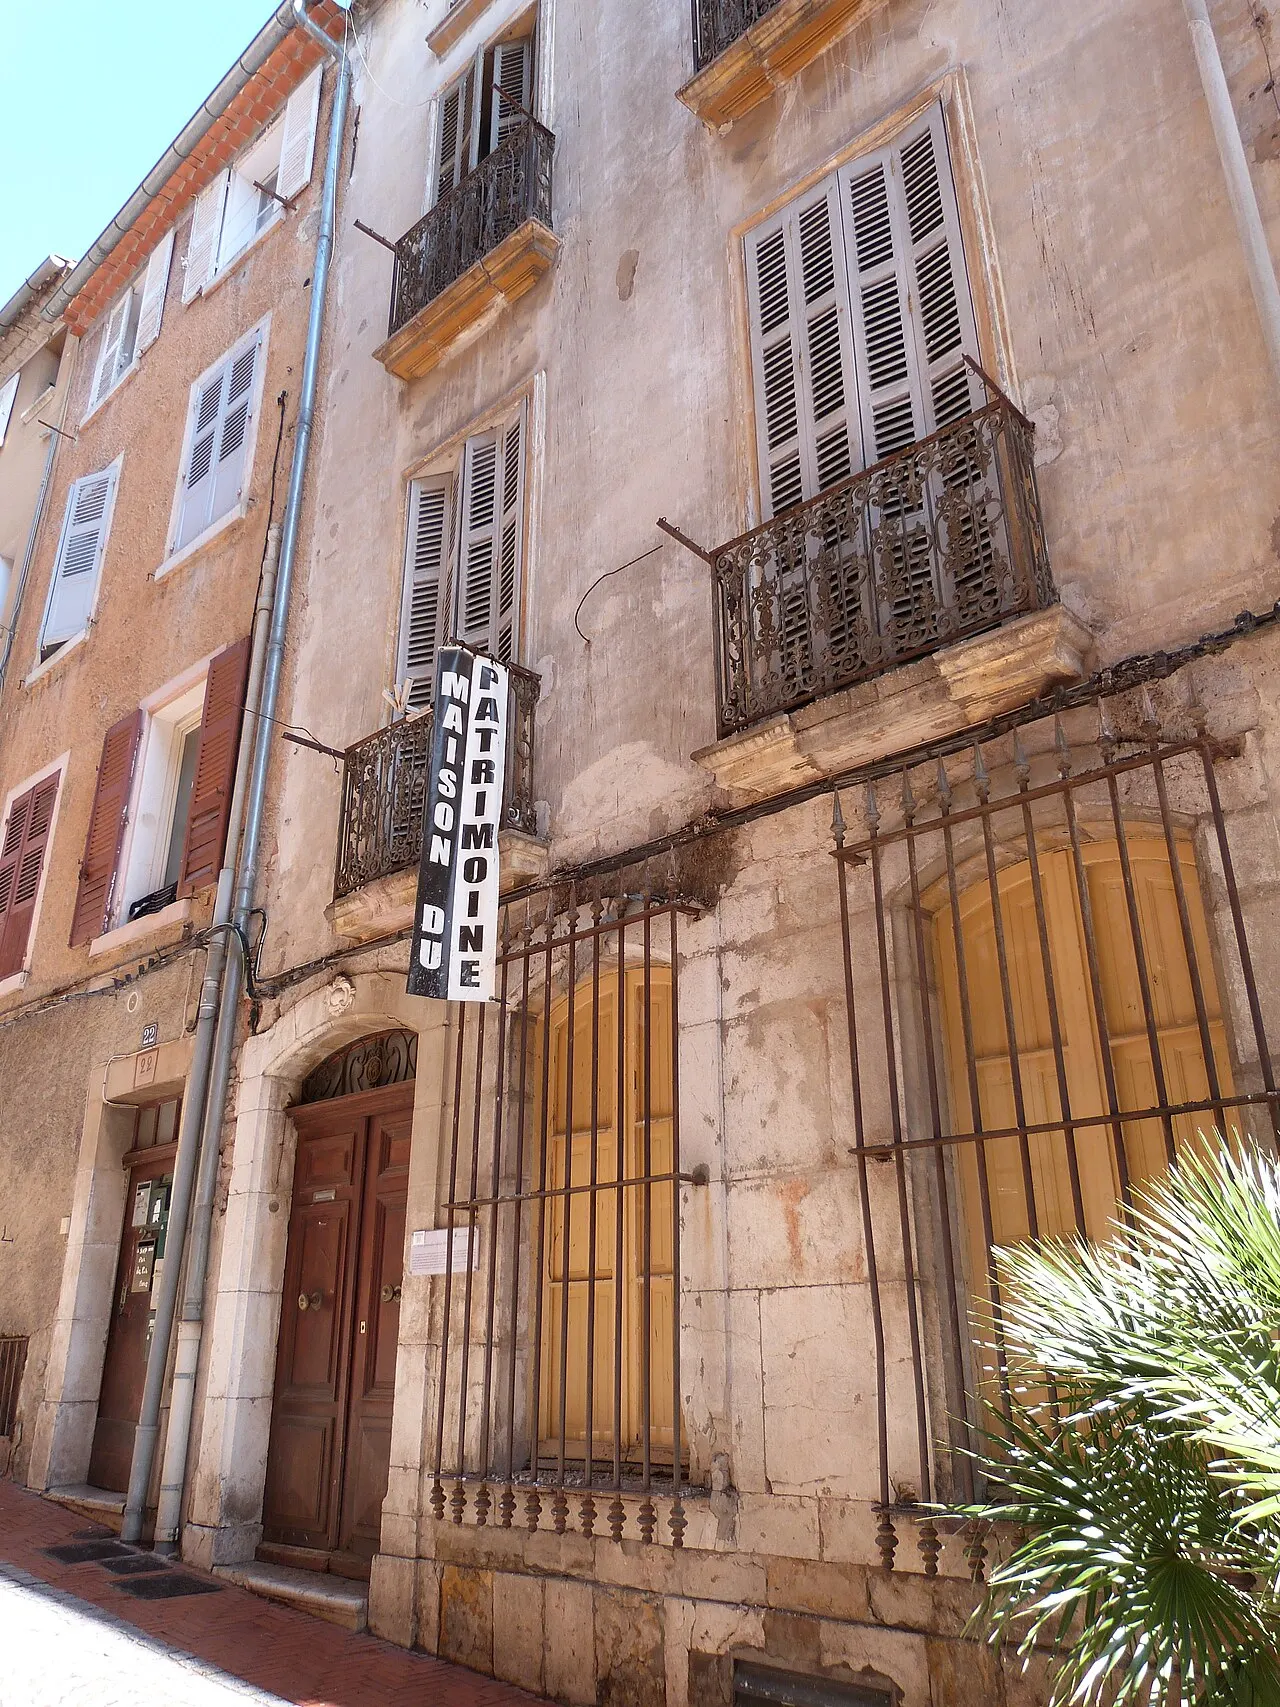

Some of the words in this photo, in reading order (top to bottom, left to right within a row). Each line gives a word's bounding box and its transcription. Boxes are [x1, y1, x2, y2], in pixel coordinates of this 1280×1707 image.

[429, 671, 470, 867] MAISON
[458, 665, 499, 988] PATRIMOINE
[419, 903, 445, 970] DU
[140, 1056, 153, 1074] 22
[142, 1027, 155, 1045] 22
